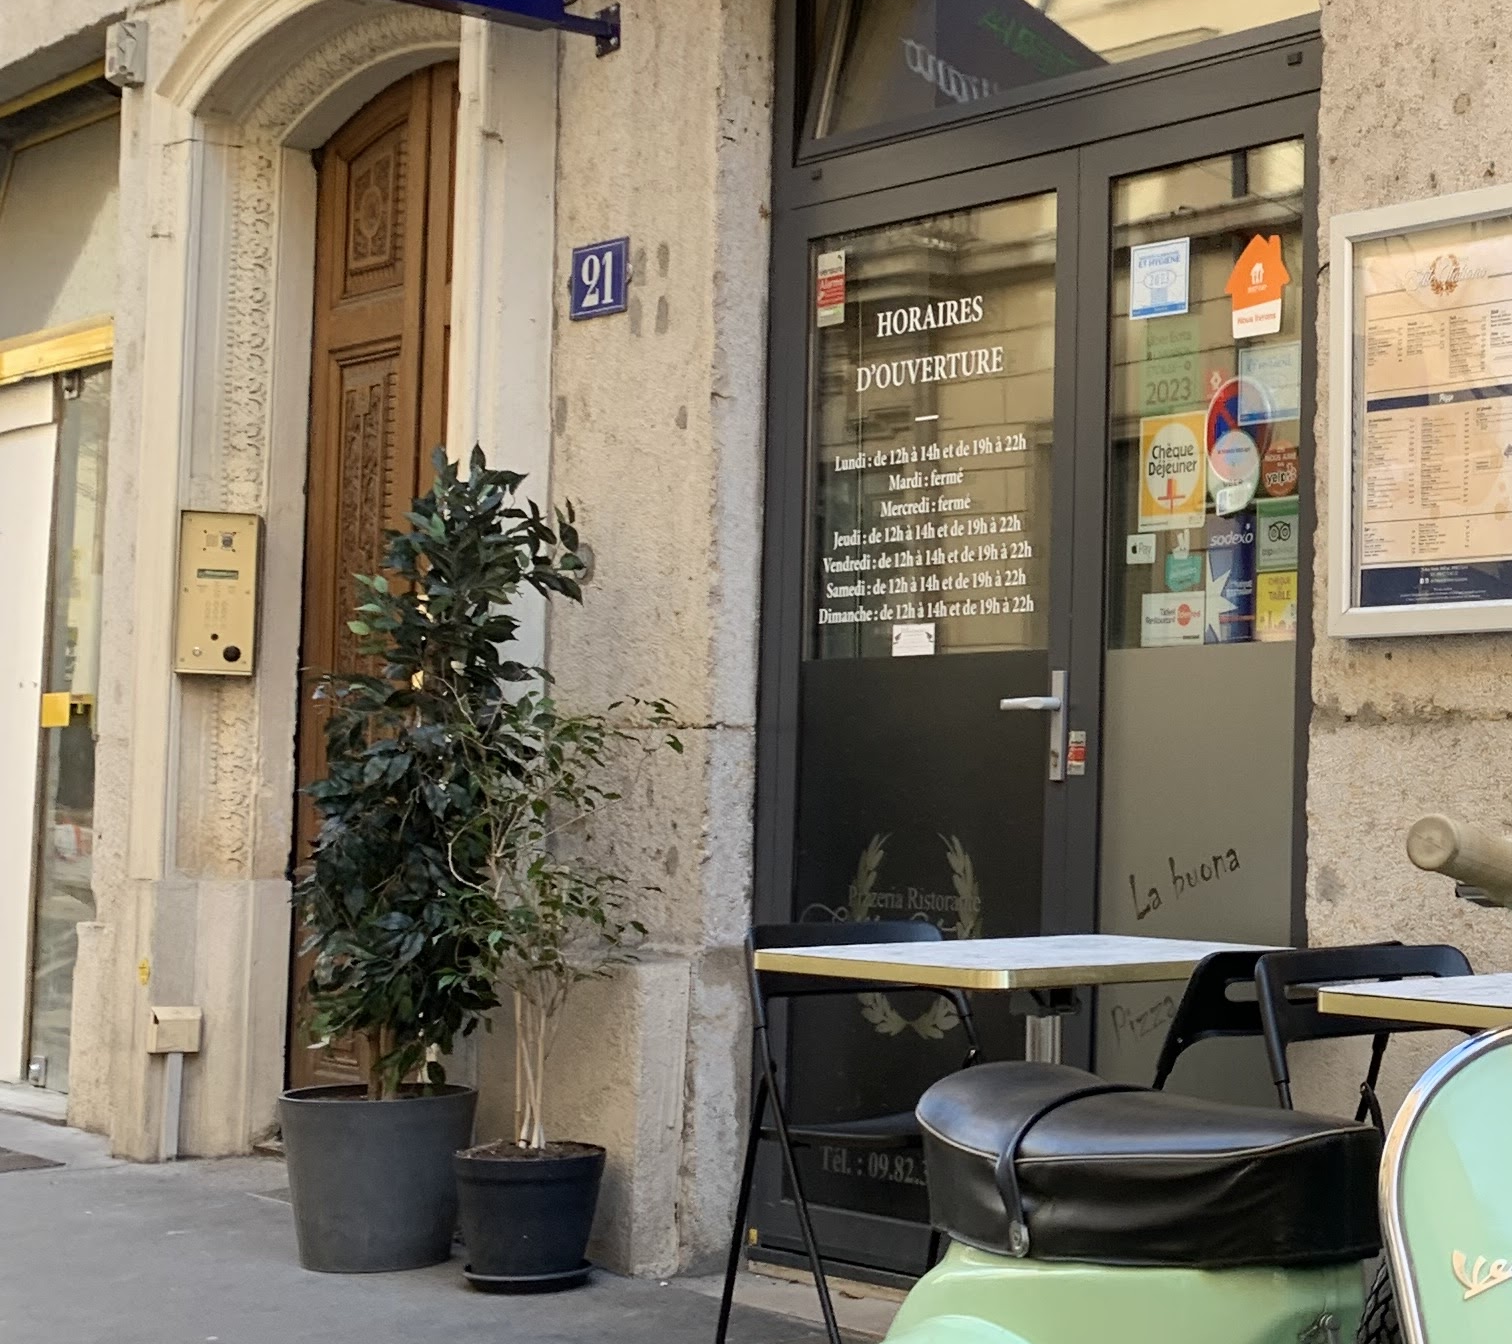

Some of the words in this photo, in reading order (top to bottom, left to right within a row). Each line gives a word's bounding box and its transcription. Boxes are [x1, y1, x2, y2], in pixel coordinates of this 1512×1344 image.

[580, 250, 613, 309] 21
[876, 295, 983, 338] HORAIRES
[856, 346, 1004, 392] D'OUVERTURE
[1146, 375, 1191, 406] 2023
[873, 450, 887, 467] de
[890, 447, 909, 465] 12h
[911, 446, 917, 462] à
[921, 443, 940, 461] 14h
[942, 444, 954, 458] et
[955, 440, 969, 457] de
[973, 437, 992, 455] 19h
[995, 436, 1002, 453] à
[1005, 433, 1027, 451] 22h
[1152, 443, 1194, 462] Chèque
[930, 467, 964, 487] fermé
[1148, 459, 1197, 478] Déjeuner
[938, 493, 971, 512] fermé
[868, 527, 882, 544] de
[884, 525, 904, 543] 12h
[905, 524, 912, 541] à
[915, 522, 935, 540] 14h
[937, 523, 948, 538] et
[950, 519, 964, 537] de
[967, 517, 988, 535] 19h
[990, 516, 997, 533] à
[999, 514, 1021, 532] 22h
[878, 552, 892, 569] de
[894, 550, 914, 568] 12h
[916, 549, 923, 566] à
[925, 548, 945, 565] 14h
[947, 549, 959, 564] et
[961, 546, 974, 563] de
[978, 543, 998, 562] 19h
[1000, 542, 1007, 560] à
[1010, 540, 1032, 559] 22h
[873, 578, 886, 595] de
[888, 576, 908, 594] 12h
[910, 576, 917, 592] à
[920, 574, 940, 592] 14h
[942, 575, 953, 590] et
[955, 572, 970, 590] de
[972, 570, 993, 588] 19h
[995, 570, 1002, 587] à
[1004, 568, 1026, 586] 22h
[880, 604, 893, 621] de
[896, 602, 915, 619] 12h
[917, 602, 924, 619] à
[927, 600, 947, 618] 14h
[949, 601, 960, 617] et
[962, 598, 977, 615] de
[979, 596, 1000, 615] 19h
[1002, 596, 1009, 613] à
[1012, 594, 1034, 613] 22h
[1129, 873, 1163, 921] La
[1169, 848, 1241, 900] buona
[820, 1145, 851, 1175] Tél.
